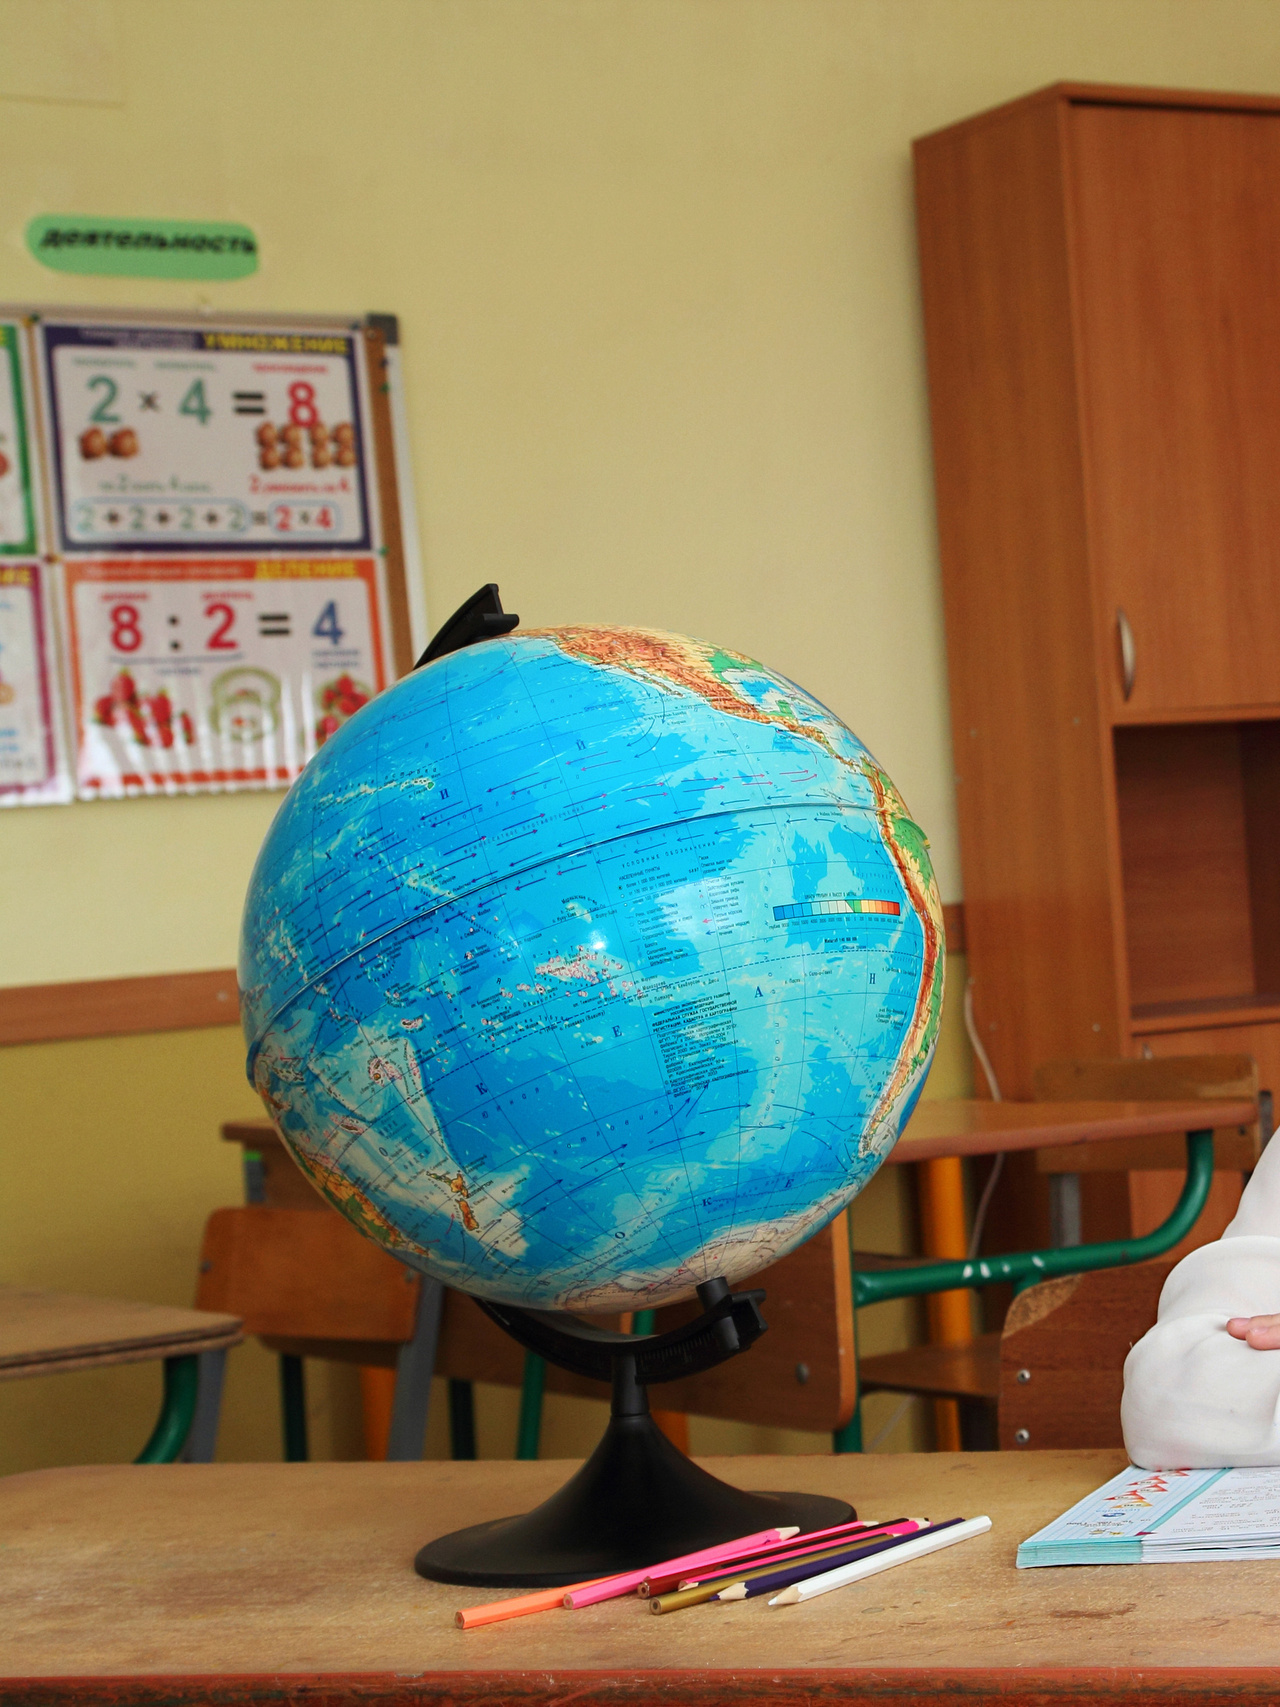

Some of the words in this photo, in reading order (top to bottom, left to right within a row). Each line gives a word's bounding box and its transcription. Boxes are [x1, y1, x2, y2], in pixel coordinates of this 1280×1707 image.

[39, 228, 258, 255] деятельность
[87, 375, 120, 423] 2
[178, 377, 211, 425] 4
[287, 381, 319, 427] 8
[274, 506, 292, 531] 2
[315, 506, 333, 529] 4
[254, 562, 358, 581] ДЕЛЕНИЕ
[110, 603, 143, 652] 8
[204, 602, 238, 650] 2
[312, 600, 345, 646] 4
[652, 1016, 680, 1027] ФЕДЕРАЛЬНАЯ
[682, 1010, 698, 1018] СЛУЖБА
[700, 999, 737, 1013] ГОСУДАРСТВЕННОЙ
[683, 1015, 703, 1023] КАДАСТРА
[709, 1006, 738, 1017] КАРТОГРАФИИ
